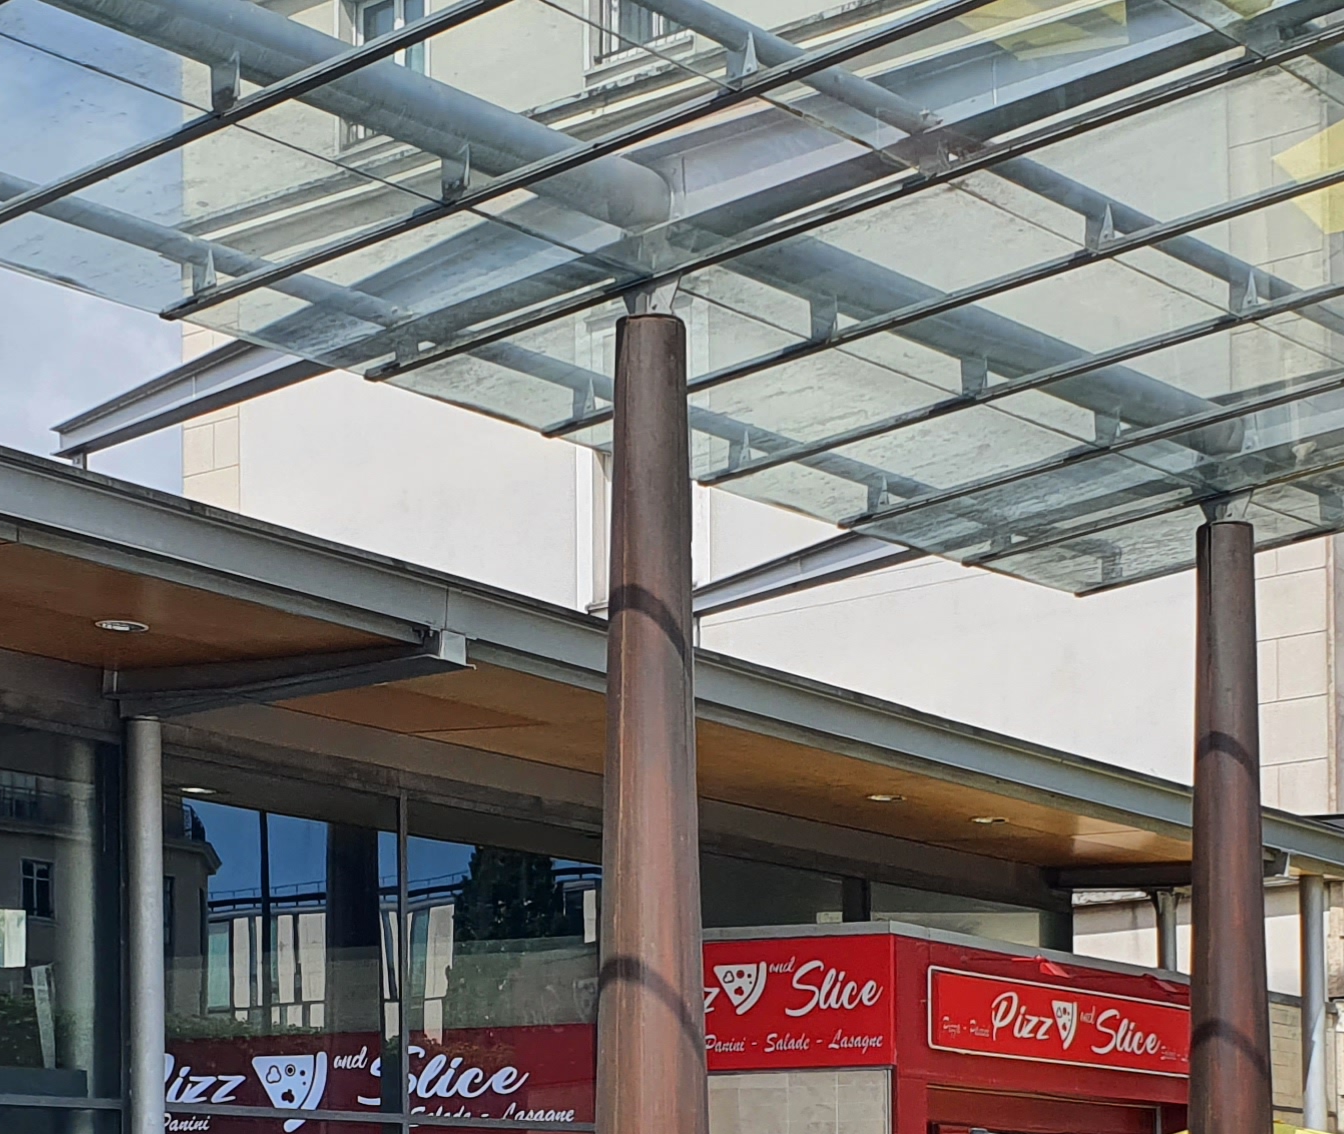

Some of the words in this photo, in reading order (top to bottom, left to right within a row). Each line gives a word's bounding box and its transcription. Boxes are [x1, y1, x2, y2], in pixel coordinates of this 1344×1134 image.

[785, 960, 883, 1017] Slice
[705, 1034, 746, 1052] Panini
[764, 1032, 810, 1053] Salade
[828, 1029, 884, 1054] Lasagne
[1091, 1009, 1161, 1055] Slice
[334, 1046, 367, 1070] and
